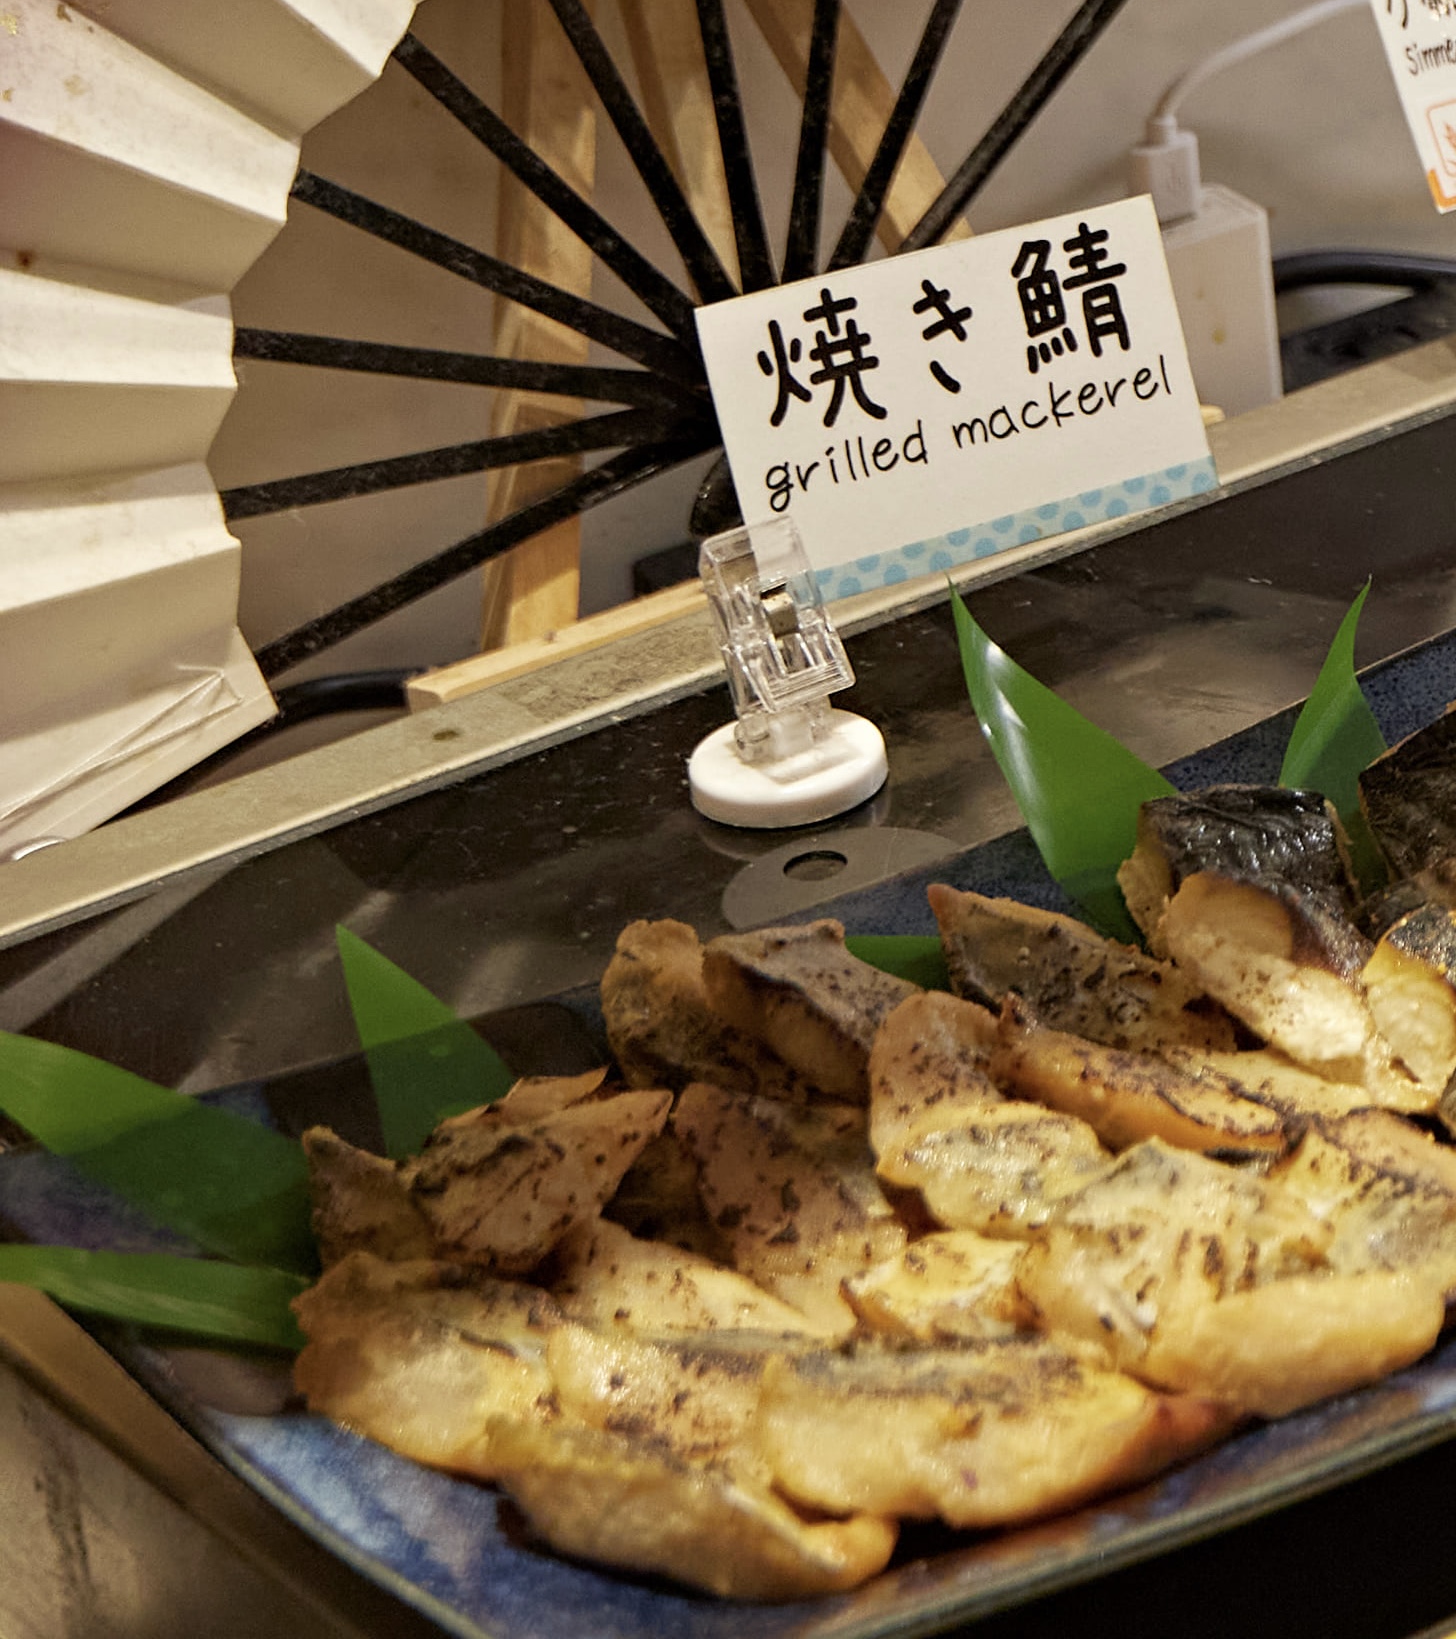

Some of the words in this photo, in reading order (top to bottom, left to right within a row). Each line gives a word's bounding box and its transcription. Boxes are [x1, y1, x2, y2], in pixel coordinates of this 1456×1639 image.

[757, 221, 1132, 429] 焼き鯖
[765, 419, 929, 513] grilled
[951, 354, 1173, 451] mackerel
